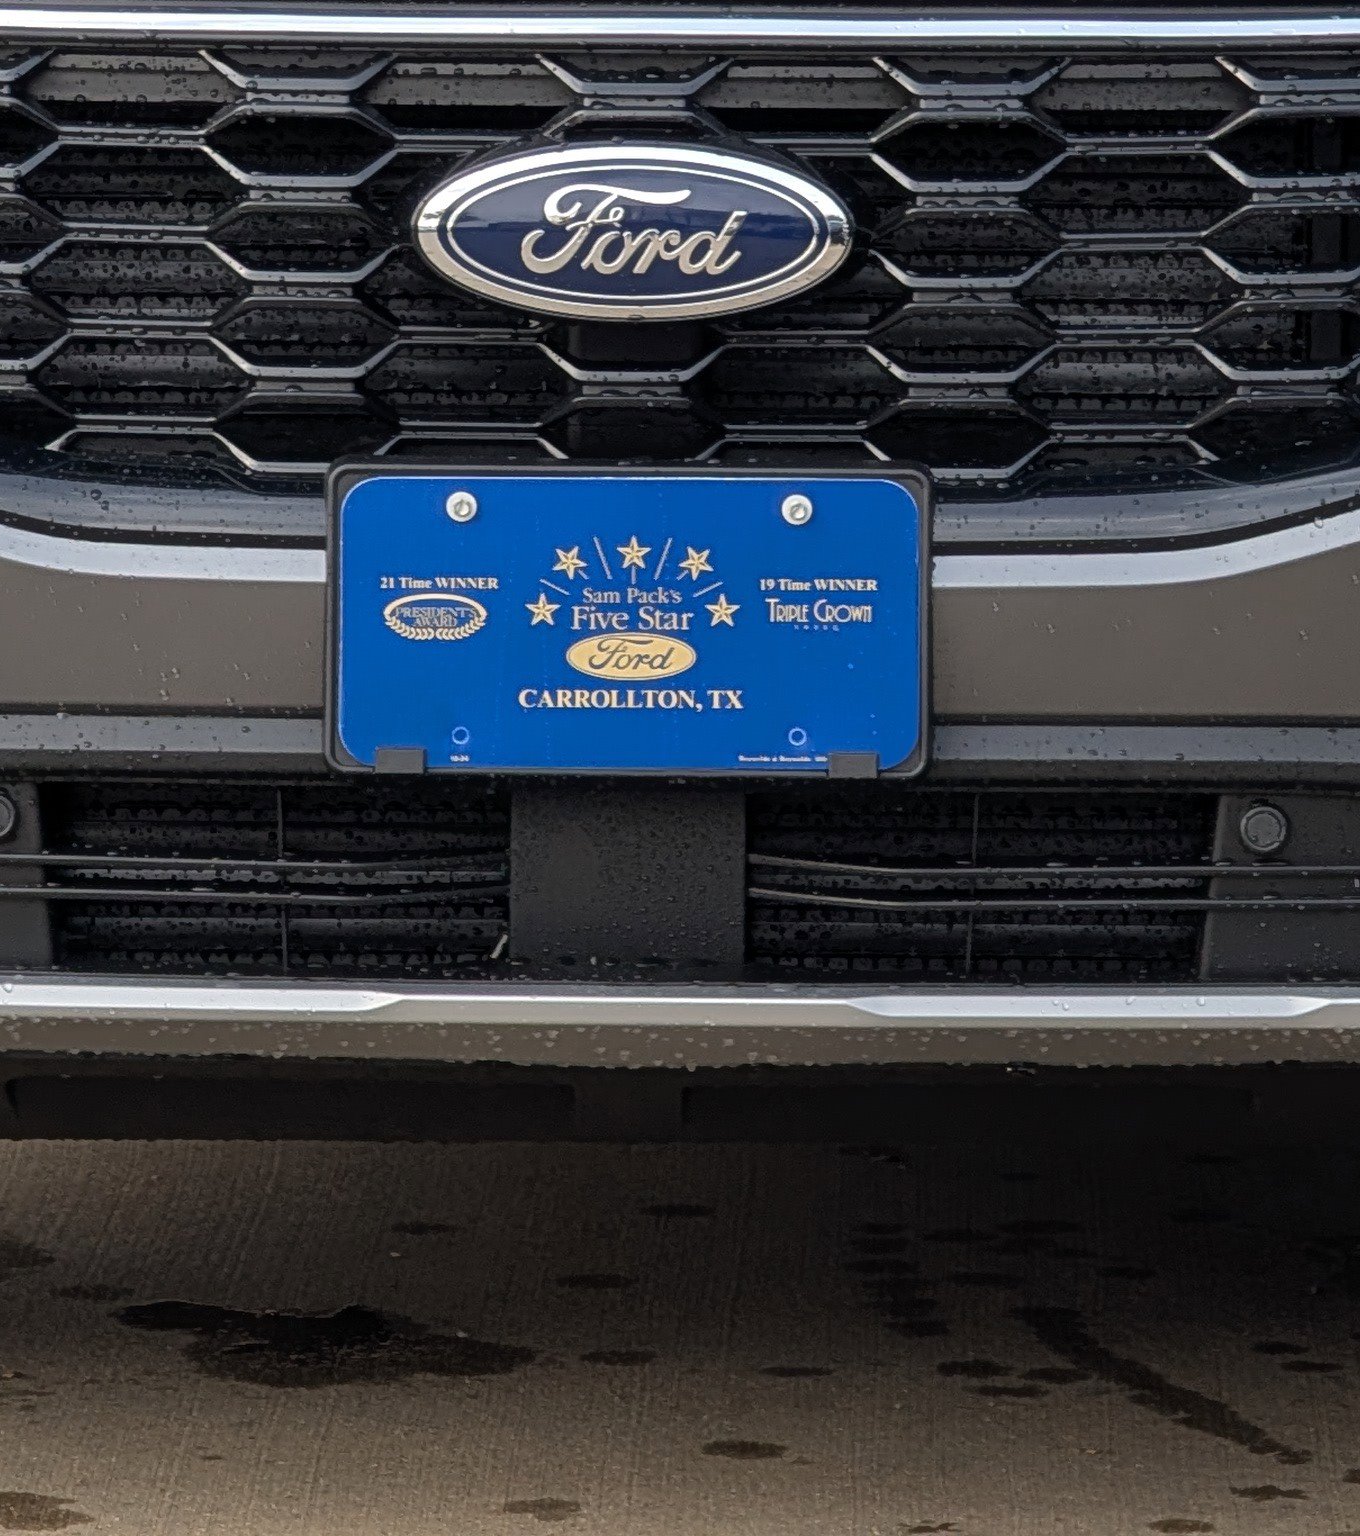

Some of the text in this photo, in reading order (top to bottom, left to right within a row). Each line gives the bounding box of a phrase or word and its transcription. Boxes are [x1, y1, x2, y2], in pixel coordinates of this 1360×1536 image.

[520, 183, 748, 275] Ford
[380, 577, 499, 590] 21 Time WINNER
[582, 586, 683, 604] Sam Pack's
[759, 578, 878, 591] 19 Time WINNER
[570, 605, 695, 631] Five Star
[765, 597, 809, 623] TRIPLE
[588, 637, 675, 670] Ford
[517, 688, 744, 712] CARROLLTON, TX
